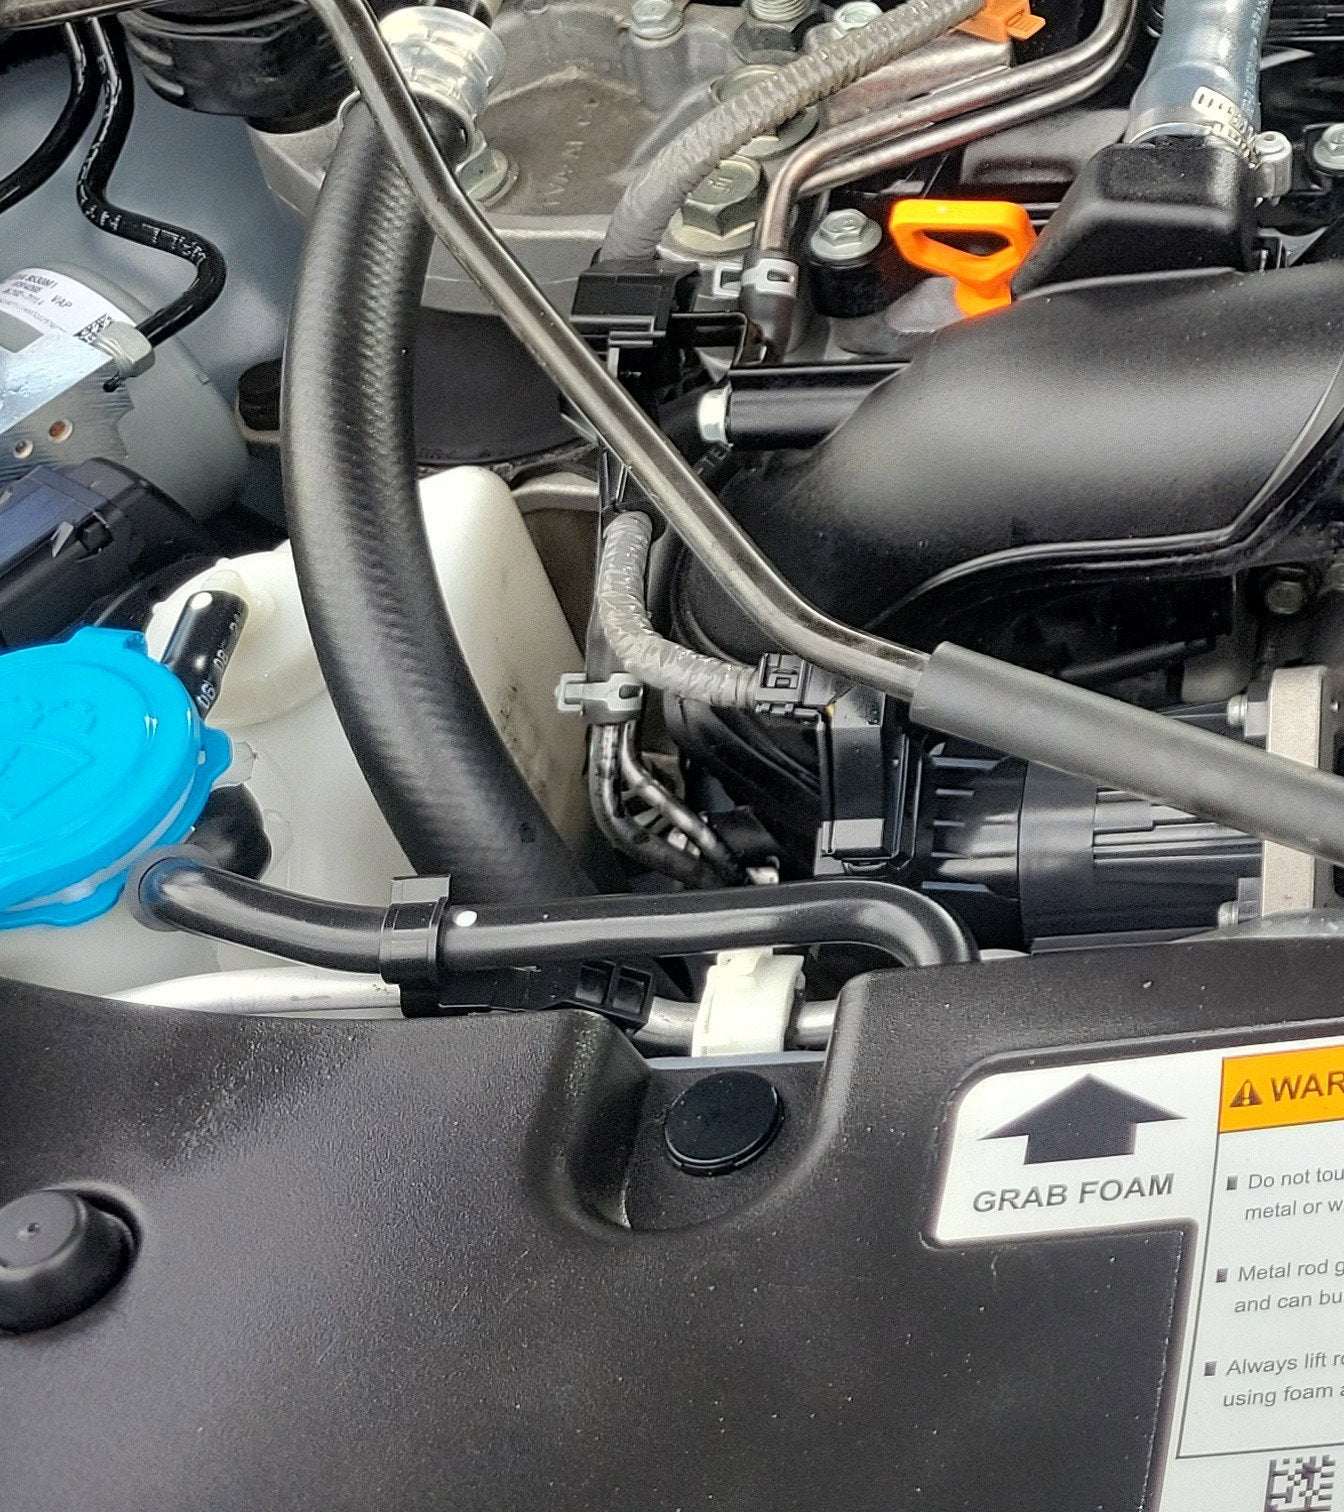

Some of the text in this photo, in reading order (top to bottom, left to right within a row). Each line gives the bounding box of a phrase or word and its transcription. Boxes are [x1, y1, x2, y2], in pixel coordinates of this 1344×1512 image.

[50, 295, 73, 309] VAP
[1248, 1173, 1275, 1190] Do
[1280, 1169, 1310, 1187] not
[972, 1172, 1174, 1213] GRAB FOAM
[1244, 1199, 1297, 1221] metal
[1302, 1201, 1323, 1215] or
[1238, 1261, 1291, 1282] Metal
[1297, 1258, 1329, 1277] rod
[1234, 1294, 1271, 1314] and
[1277, 1294, 1312, 1309] can
[1225, 1358, 1298, 1376] Always
[1304, 1351, 1327, 1369] lift
[1223, 1389, 1277, 1407] using
[1283, 1385, 1334, 1402] foam
